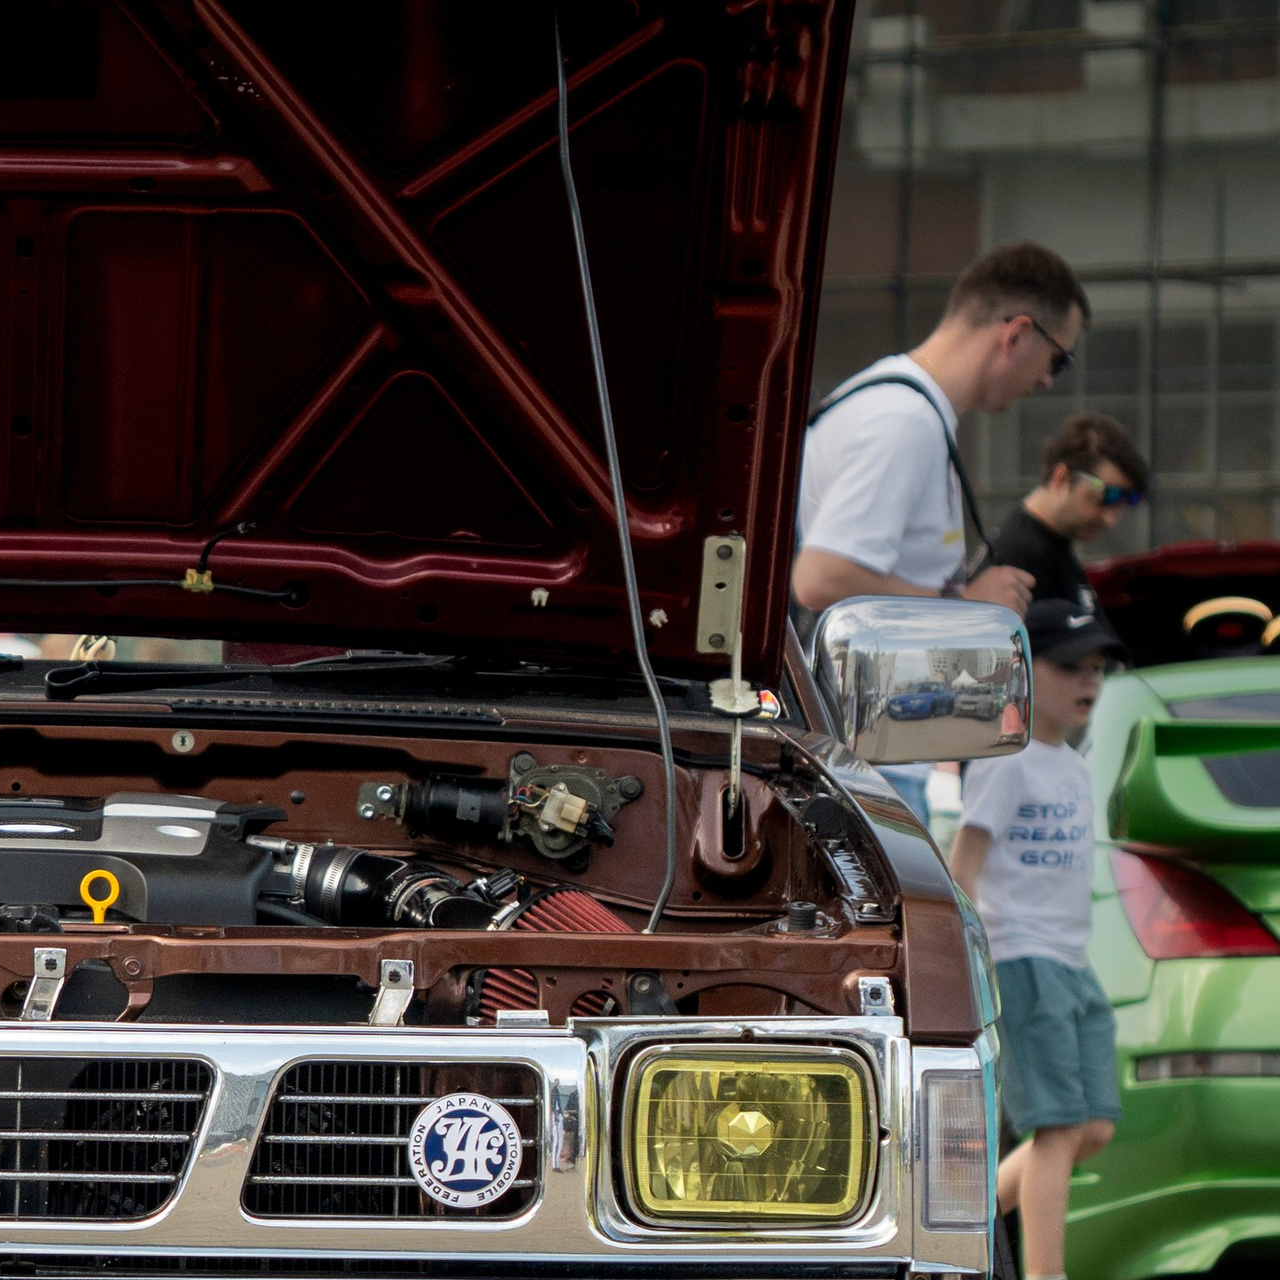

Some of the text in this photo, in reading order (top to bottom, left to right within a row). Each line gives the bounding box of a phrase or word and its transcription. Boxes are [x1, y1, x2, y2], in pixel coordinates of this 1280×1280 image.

[1018, 802, 1077, 819] STOP
[435, 1097, 492, 1114] JAPAN
[412, 1124, 460, 1203] FEDERATION
[477, 1122, 518, 1201] AUTOMOBILE
